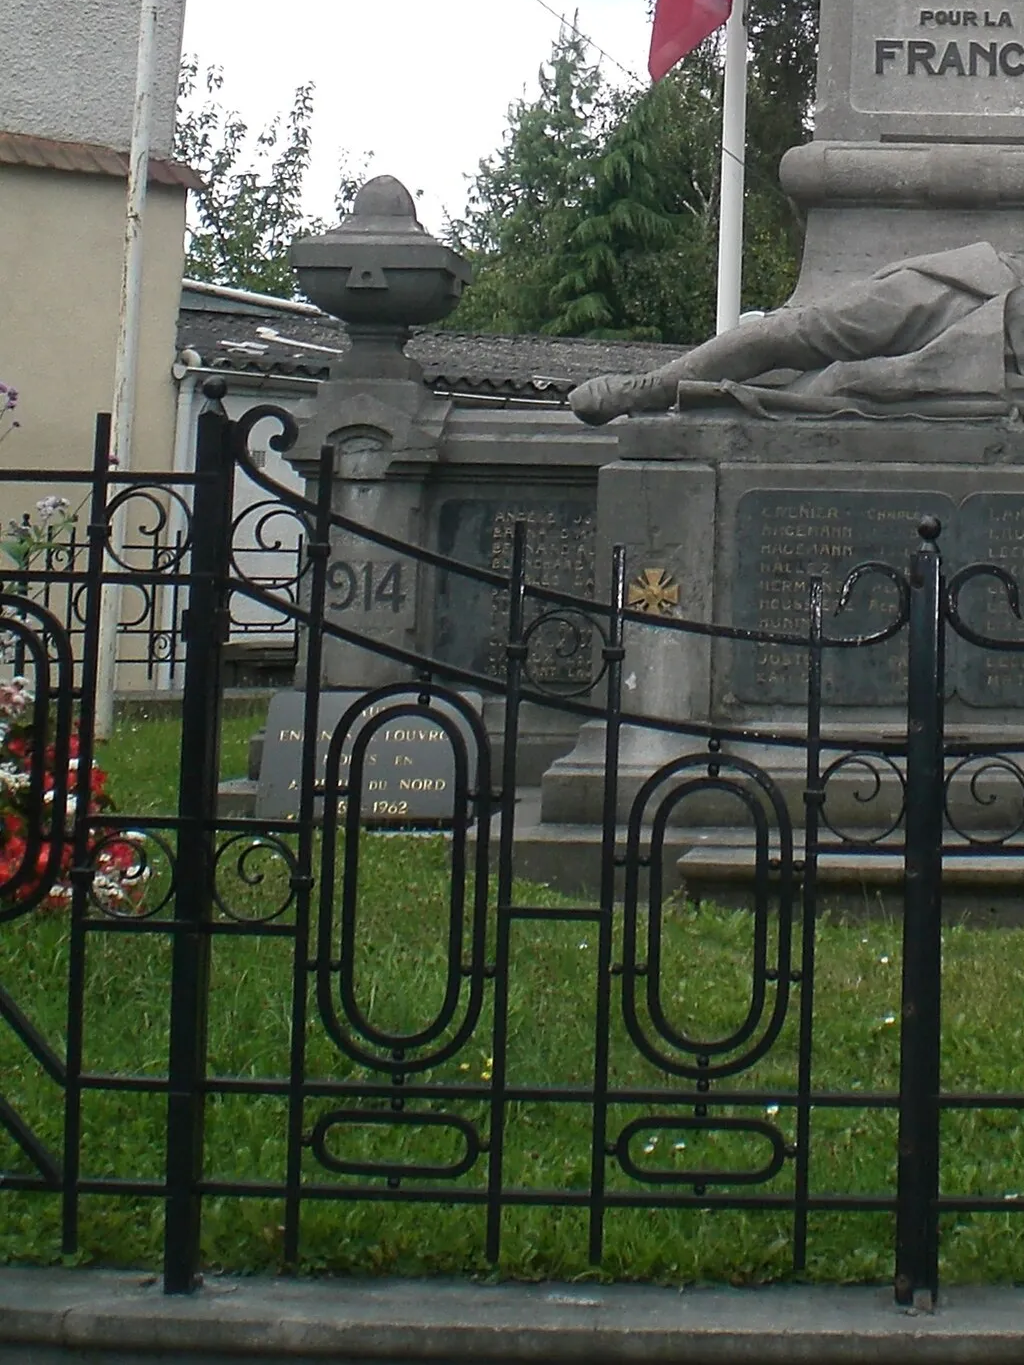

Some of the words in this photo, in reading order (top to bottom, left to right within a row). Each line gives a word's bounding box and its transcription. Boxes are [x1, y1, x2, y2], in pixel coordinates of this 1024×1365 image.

[919, 10, 980, 28] POUR
[983, 10, 1013, 28] LA
[327, 560, 407, 614] 914
[394, 754, 413, 766] EN
[368, 779, 383, 792] DU
[399, 777, 447, 792] NORD
[372, 800, 408, 815] 1962
